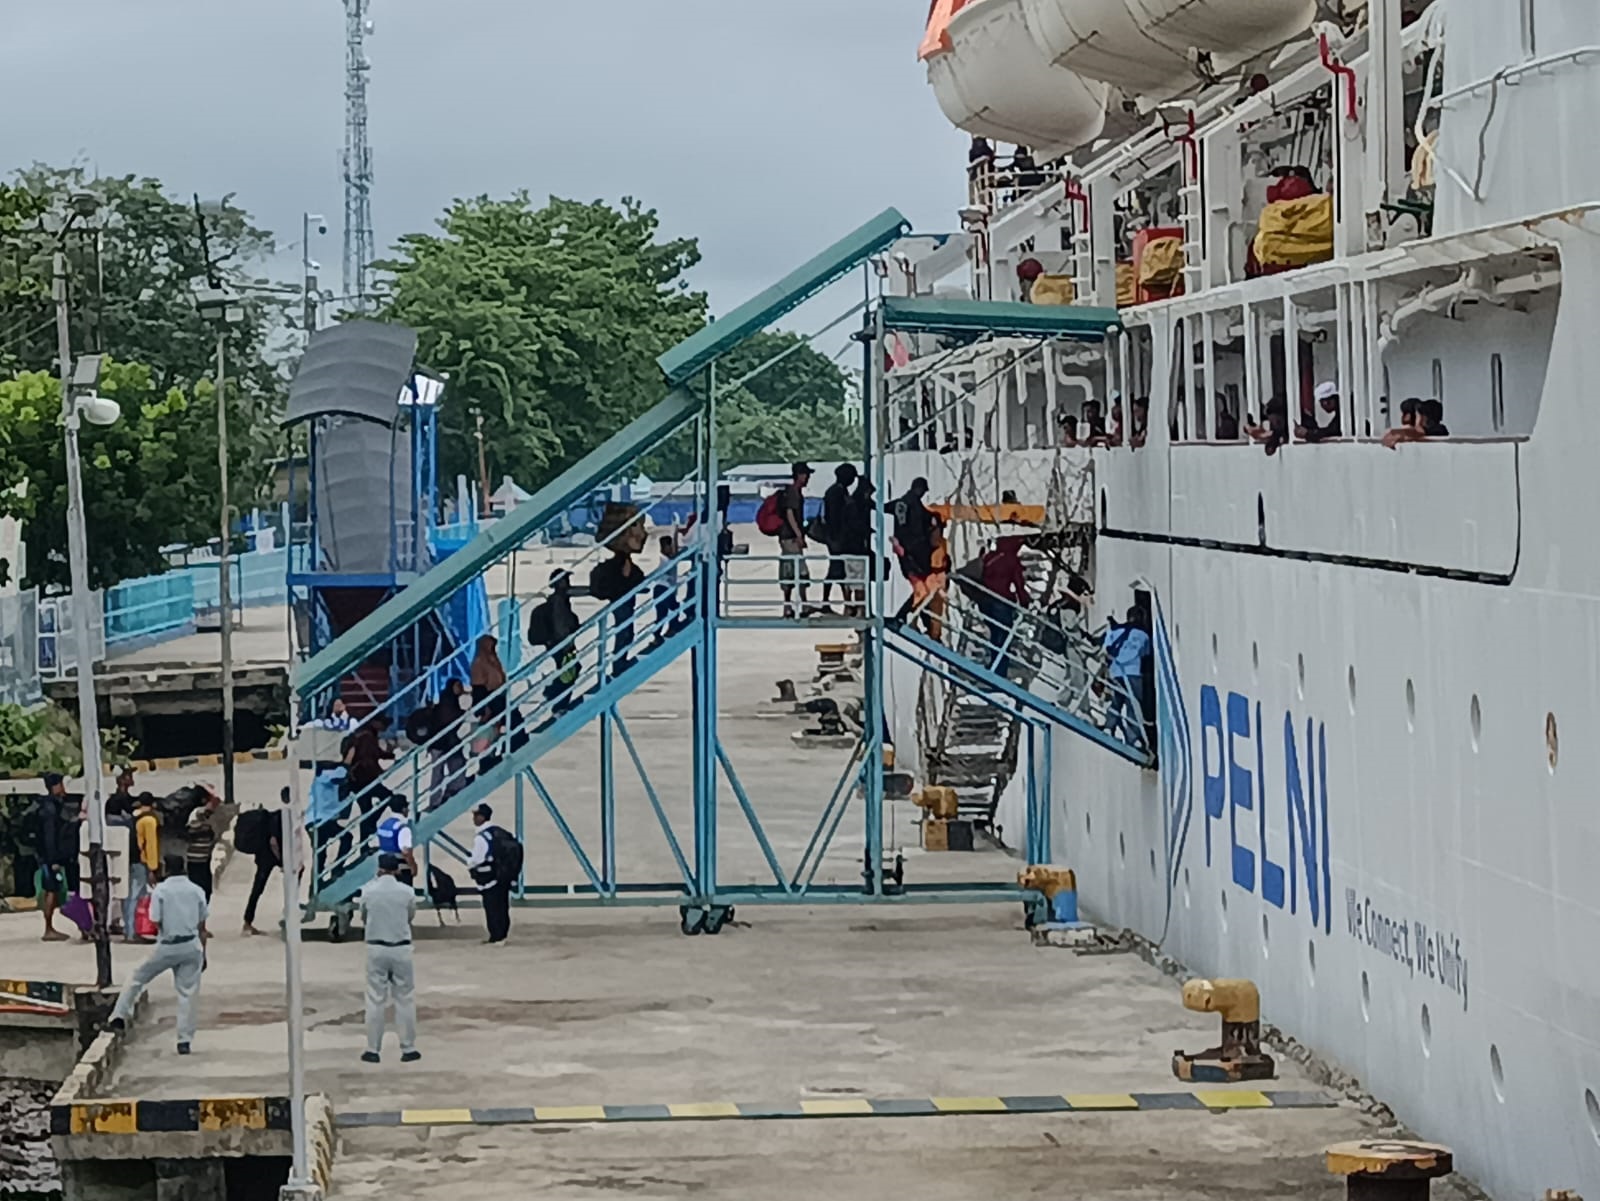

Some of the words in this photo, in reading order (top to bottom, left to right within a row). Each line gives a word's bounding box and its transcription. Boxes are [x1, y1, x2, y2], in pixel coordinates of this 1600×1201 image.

[1200, 684, 1332, 936] PELNI
[1345, 886, 1362, 941] We
[1414, 920, 1435, 979] We
[1436, 930, 1468, 1012] Unify
